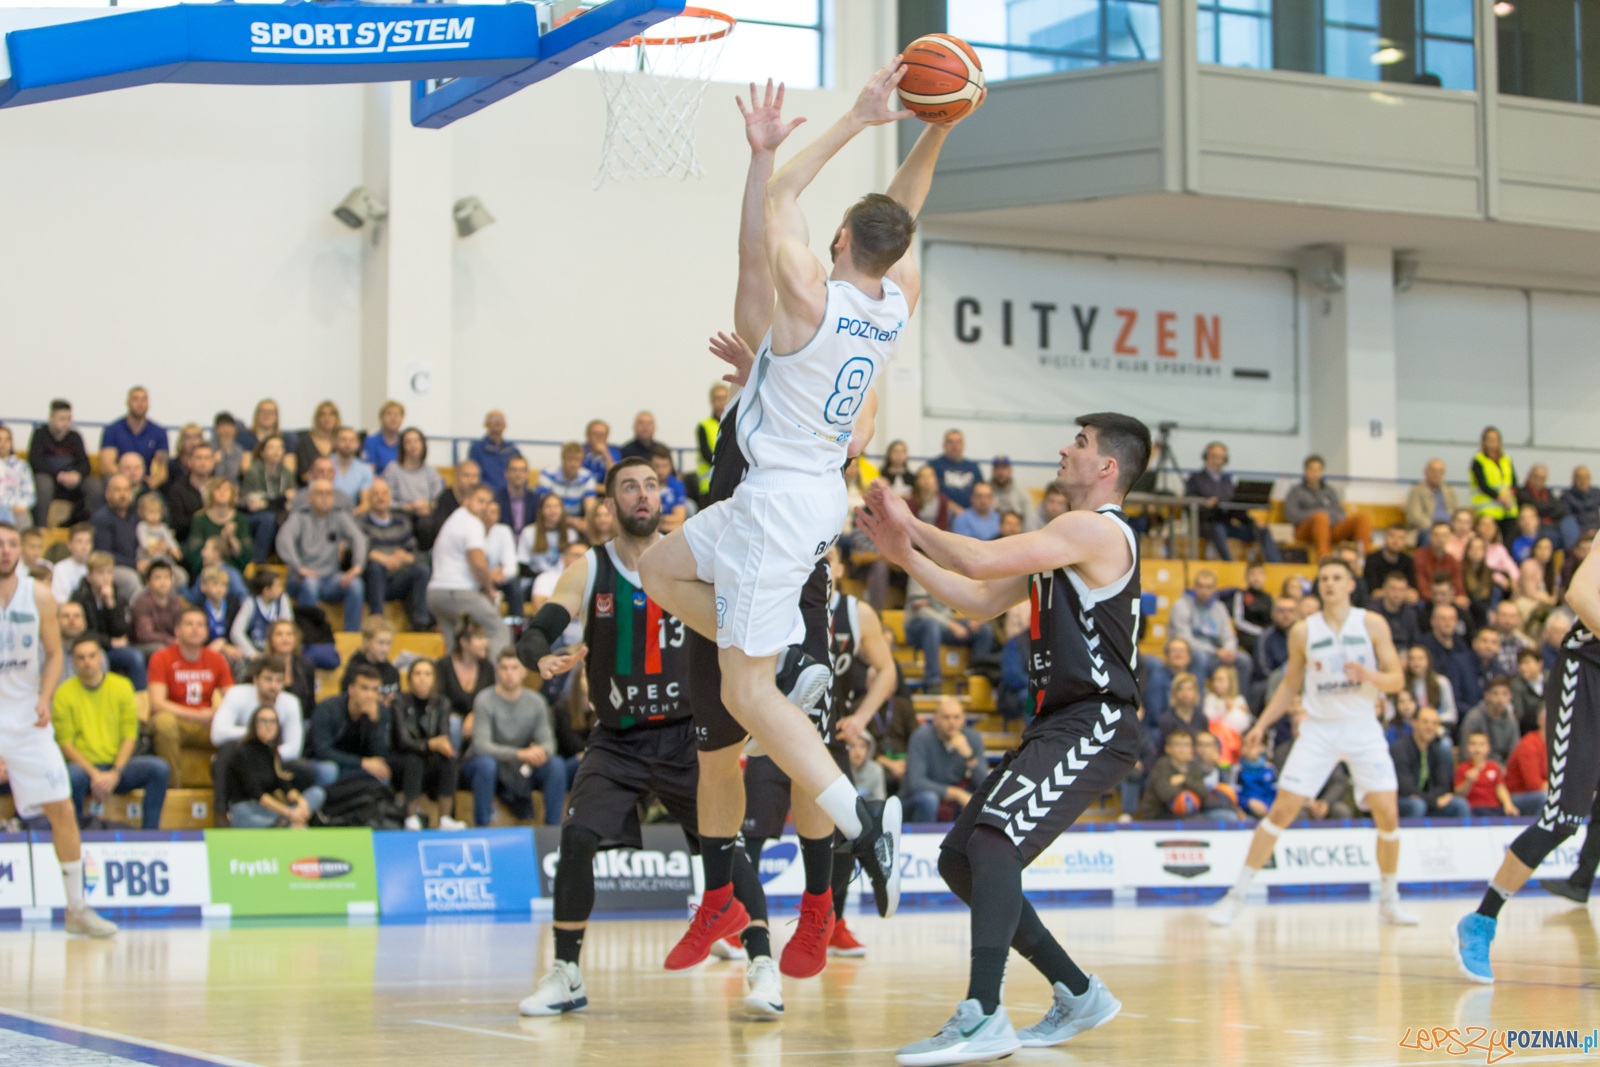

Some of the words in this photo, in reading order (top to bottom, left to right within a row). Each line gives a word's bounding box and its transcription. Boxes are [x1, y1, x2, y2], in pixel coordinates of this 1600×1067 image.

[251, 21, 352, 46] SPORT
[355, 17, 475, 46] SYSTEM
[954, 296, 1221, 361] CITYZEN
[824, 357, 874, 425] 8
[657, 616, 686, 649] 13
[627, 682, 680, 701] PEC
[987, 769, 1037, 808] 17
[230, 859, 278, 877] Frytki
[1285, 846, 1370, 867] NICKEL
[105, 860, 170, 896] PBG
[425, 878, 494, 901] HOTEL
